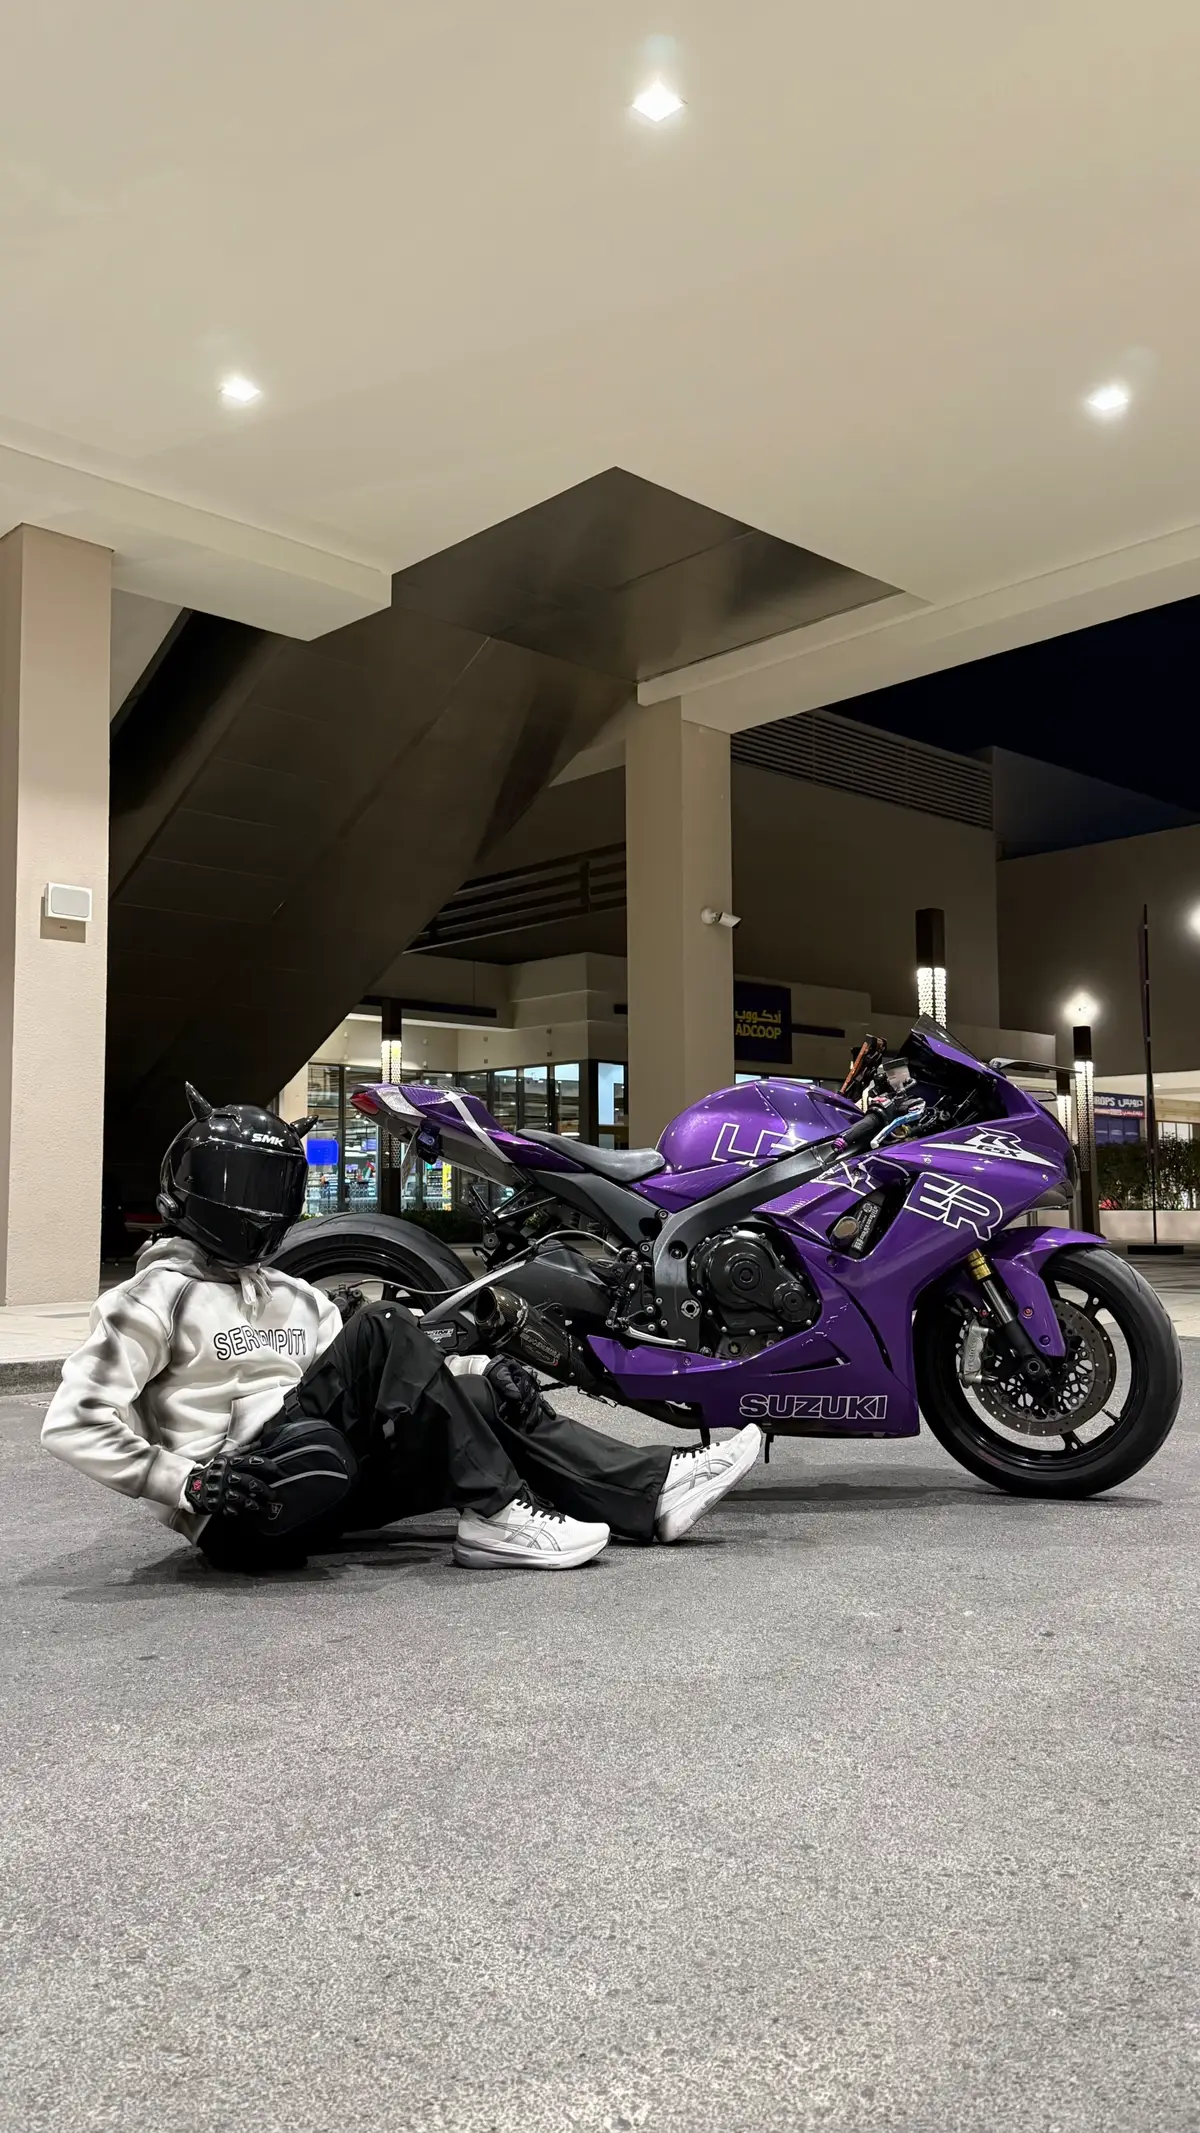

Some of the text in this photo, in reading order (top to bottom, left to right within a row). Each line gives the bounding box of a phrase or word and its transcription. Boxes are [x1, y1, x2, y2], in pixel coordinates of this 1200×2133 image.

[735, 1023, 782, 1040] ADCOOP
[1093, 1095, 1116, 1107] ROPS
[251, 1132, 285, 1148] SMK
[739, 1393, 888, 1420] SUZUKI
